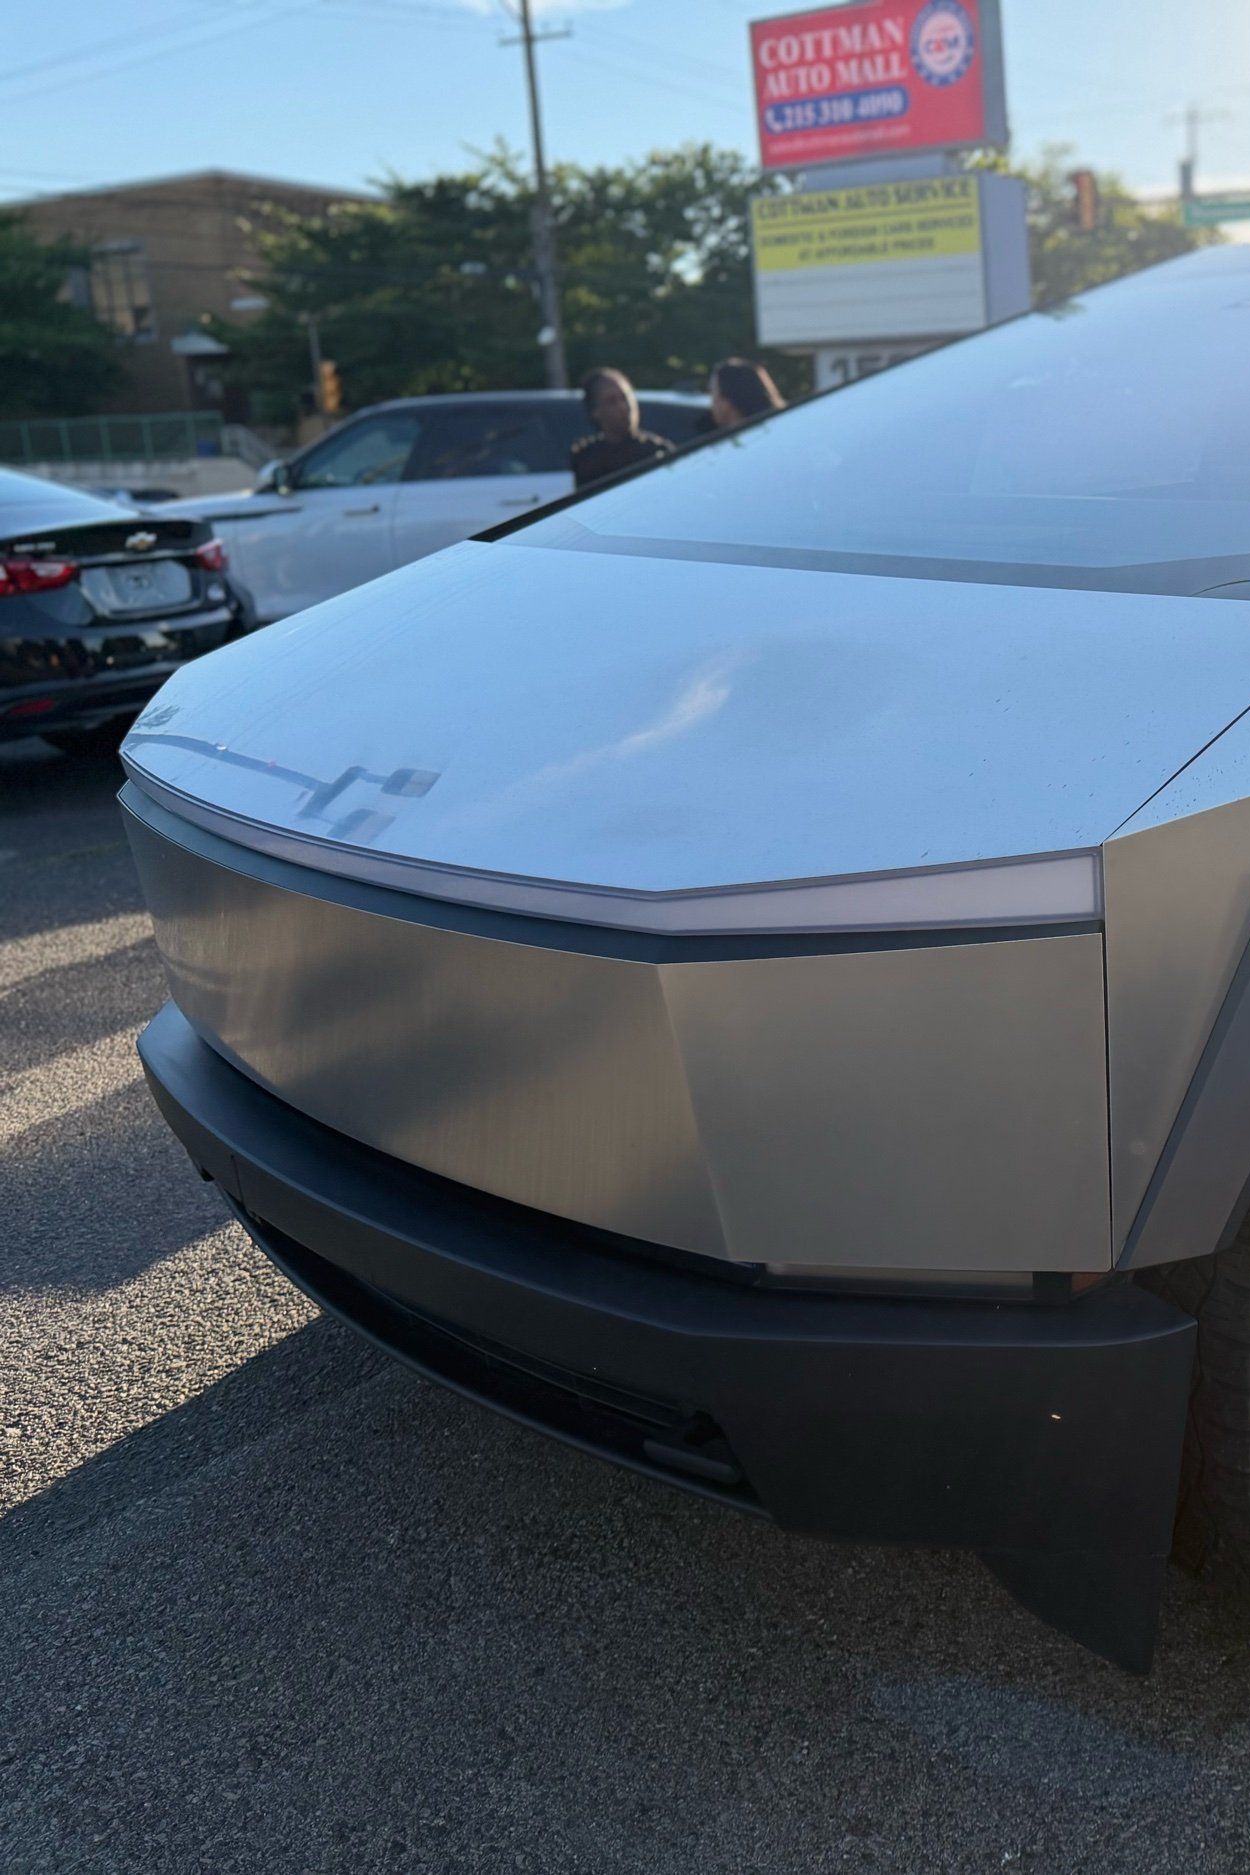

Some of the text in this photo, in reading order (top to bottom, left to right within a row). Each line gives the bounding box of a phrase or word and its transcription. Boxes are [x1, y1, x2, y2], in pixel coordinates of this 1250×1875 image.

[759, 18, 904, 68] COTTMAN
[763, 63, 830, 99] AUTO
[836, 52, 907, 86] MALL
[758, 179, 969, 220] COTTMAN AUTO SERVICE
